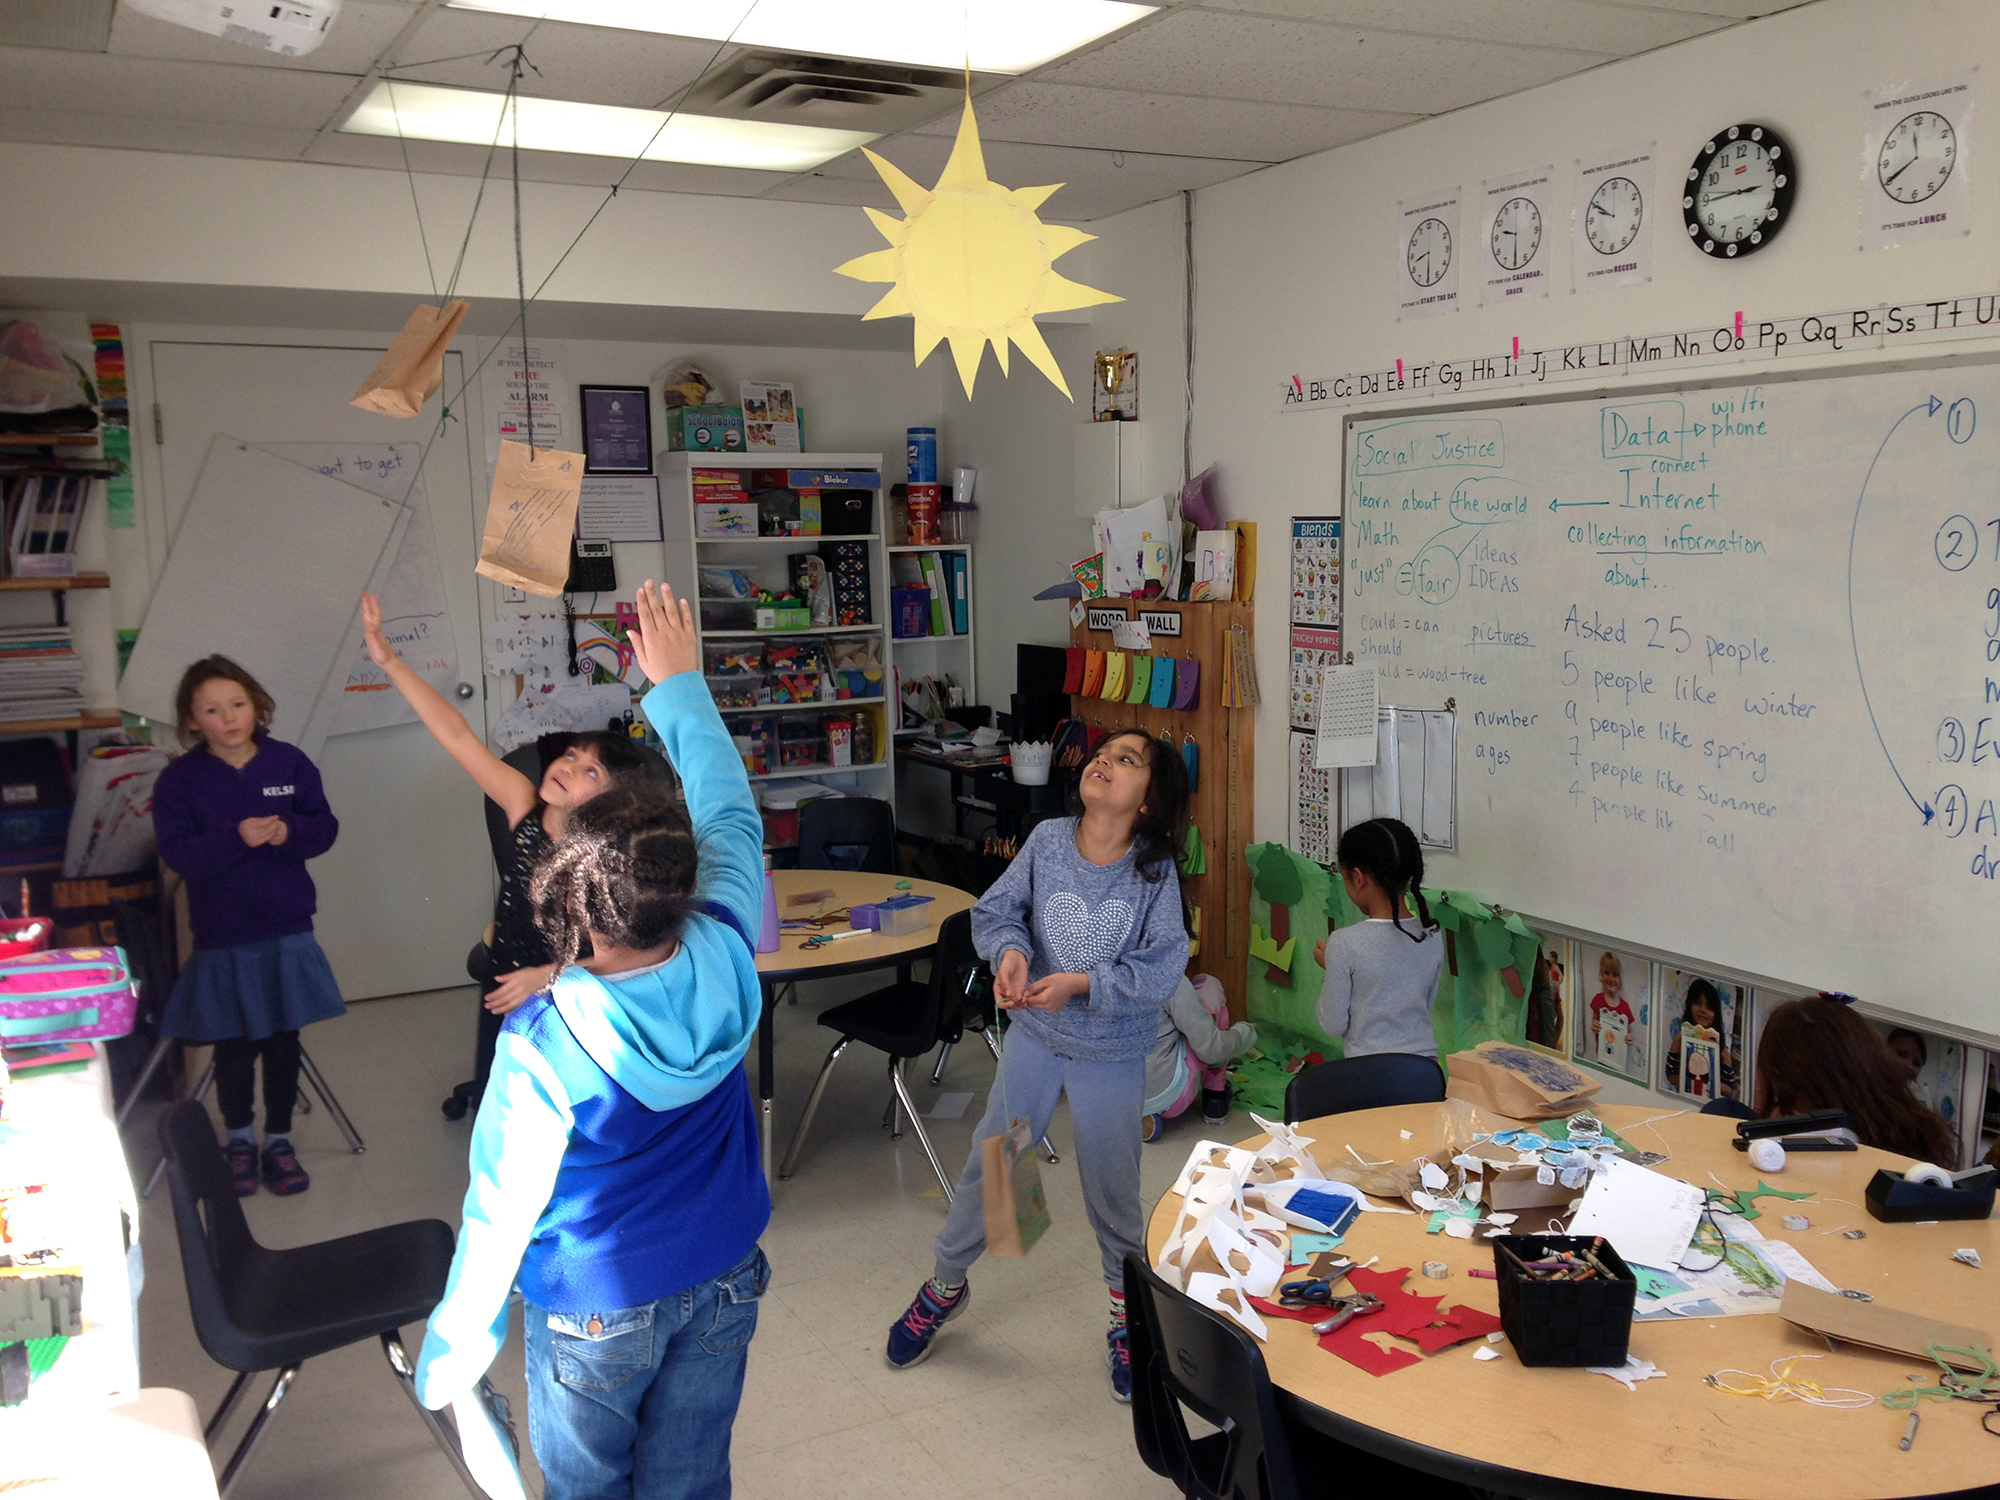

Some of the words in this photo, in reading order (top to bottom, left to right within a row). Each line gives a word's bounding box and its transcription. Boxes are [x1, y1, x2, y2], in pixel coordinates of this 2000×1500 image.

[1874, 101, 1891, 109] WHEN
[1904, 94, 1921, 103] CLOCK
[1922, 91, 1940, 99] LOOKS
[1914, 116, 1923, 126] 12
[1933, 119, 1936, 128] 1
[1900, 125, 1906, 134] 11
[1941, 129, 1949, 138] 2
[1736, 144, 1747, 159] 12
[1885, 140, 1896, 150] 10
[1945, 147, 1952, 156] 3
[1756, 147, 1761, 160] 1
[1720, 155, 1729, 168] 11
[1767, 159, 1774, 172] 2
[1883, 160, 1889, 168] 9
[1939, 166, 1946, 175] 4
[1709, 172, 1720, 186] 10
[1897, 188, 1902, 198] 7
[1927, 182, 1934, 191] 5
[1703, 194, 1709, 207] 9
[1911, 190, 1918, 199] 6
[1708, 213, 1714, 226] 8
[1753, 218, 1760, 230] 5
[1919, 213, 1946, 225] LUNCH
[1720, 225, 1727, 238] 7
[1736, 227, 1743, 240] 6
[1614, 262, 1637, 272] RECESS
[1420, 295, 1436, 304] START
[1437, 293, 1446, 302] THE
[1447, 292, 1457, 300] DAY
[1506, 287, 1523, 296] SNACK
[1286, 386, 1303, 403] Aa
[1310, 382, 1327, 401] Bb
[1334, 379, 1352, 398] Cc
[1361, 374, 1378, 395] Dd
[1387, 372, 1404, 391] Ee
[1413, 367, 1430, 388] Ff
[1439, 364, 1462, 391] Gg
[1472, 359, 1495, 380] Hh
[1504, 356, 1518, 377] Ii
[1531, 352, 1546, 381] Jj
[1563, 347, 1586, 370] Kk
[1598, 343, 1616, 365] Ll
[1631, 338, 1661, 362] Mm
[1675, 334, 1700, 357] Nn
[1713, 328, 1745, 352] Oo
[1759, 323, 1788, 356] Pp
[1802, 317, 1842, 350] Qq
[1853, 311, 1880, 337] Rr
[1887, 307, 1916, 334] Ss
[1926, 300, 1962, 329] Tt
[1977, 296, 2000, 324] U
[506, 360, 522, 368] YOU
[514, 371, 540, 380] FIRE
[508, 393, 548, 401] ALARM
[1611, 412, 1671, 450] Data
[1712, 413, 1768, 448] phone
[1361, 434, 1414, 467] Social
[1432, 432, 1496, 460] Justice
[354, 455, 372, 470] to
[378, 455, 403, 478] get
[1651, 453, 1710, 473] connect
[824, 474, 849, 484] Blokus
[1620, 468, 1720, 510] Internet
[1357, 482, 1391, 508] learn
[1402, 489, 1441, 511] about
[1450, 490, 1480, 512] the
[1486, 496, 1528, 514] world
[1357, 524, 1399, 548] Math
[1568, 521, 1648, 566] collecting
[1664, 524, 1768, 554] information
[1474, 540, 1518, 566] ideas
[1418, 558, 1452, 594] fair
[1468, 564, 1519, 593] IDEAS
[1146, 616, 1175, 630] WALL
[1360, 612, 1396, 632] could
[1415, 620, 1440, 633] can
[1564, 603, 1626, 644] Asked
[1644, 615, 1692, 653] 25
[1293, 633, 1314, 643] TRICKY
[1315, 635, 1340, 645] VOWELS
[1472, 622, 1530, 654] pictures
[1360, 636, 1403, 656] should
[1562, 650, 1580, 686] 5
[1594, 671, 1656, 706] people
[1675, 674, 1716, 704] like
[1745, 692, 1818, 719] winter
[1474, 710, 1539, 728] number
[1565, 700, 1578, 726] 9
[1590, 717, 1646, 750] people
[1660, 721, 1692, 748] like
[1703, 738, 1767, 783] spring
[1476, 744, 1511, 775] ages
[1568, 736, 1582, 766] 7
[1591, 761, 1644, 789] people
[1656, 770, 1684, 796] like
[1698, 784, 1778, 817] summer
[1568, 780, 1586, 808] 4
